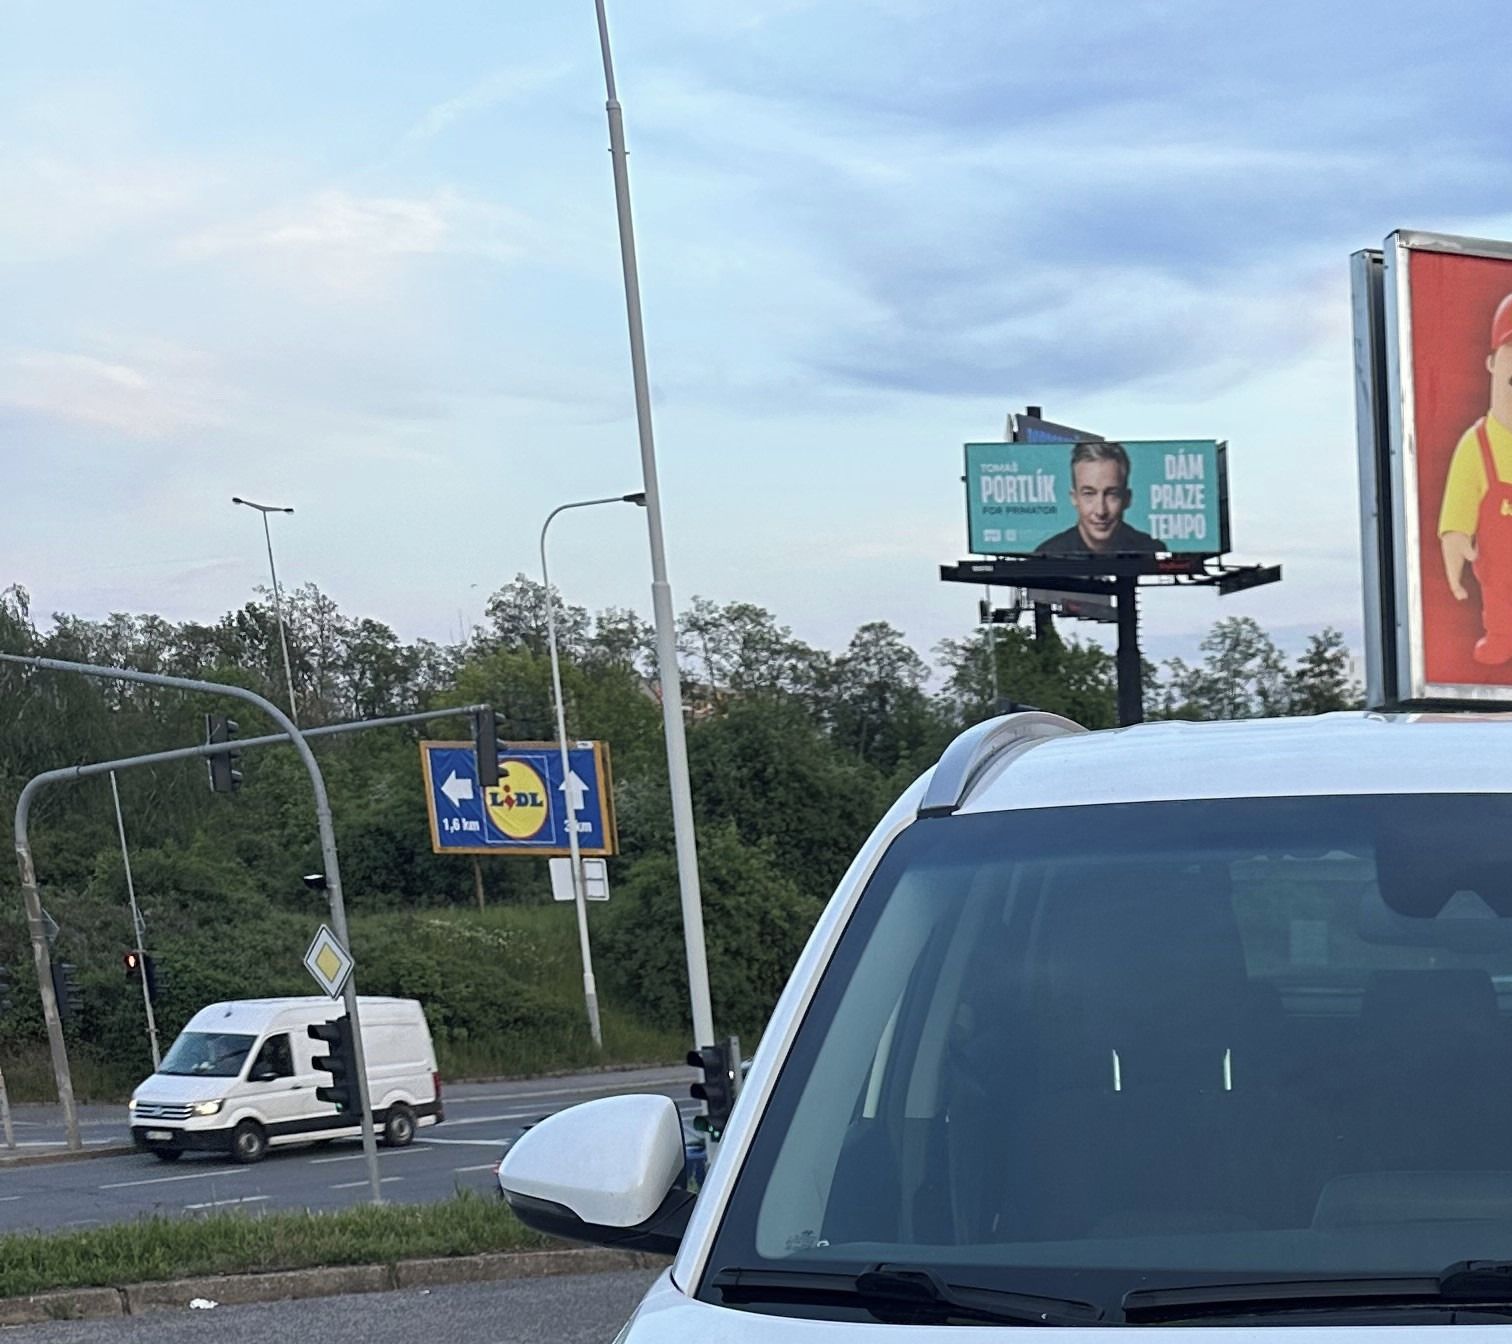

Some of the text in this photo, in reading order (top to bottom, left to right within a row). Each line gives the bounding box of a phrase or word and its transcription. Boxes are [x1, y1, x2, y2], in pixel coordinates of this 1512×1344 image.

[1165, 449, 1204, 480] DÁM
[981, 468, 1056, 503] PORTLÍK
[1150, 484, 1205, 510] PRAZE
[1149, 514, 1206, 540] TEMPO
[462, 818, 480, 831] km
